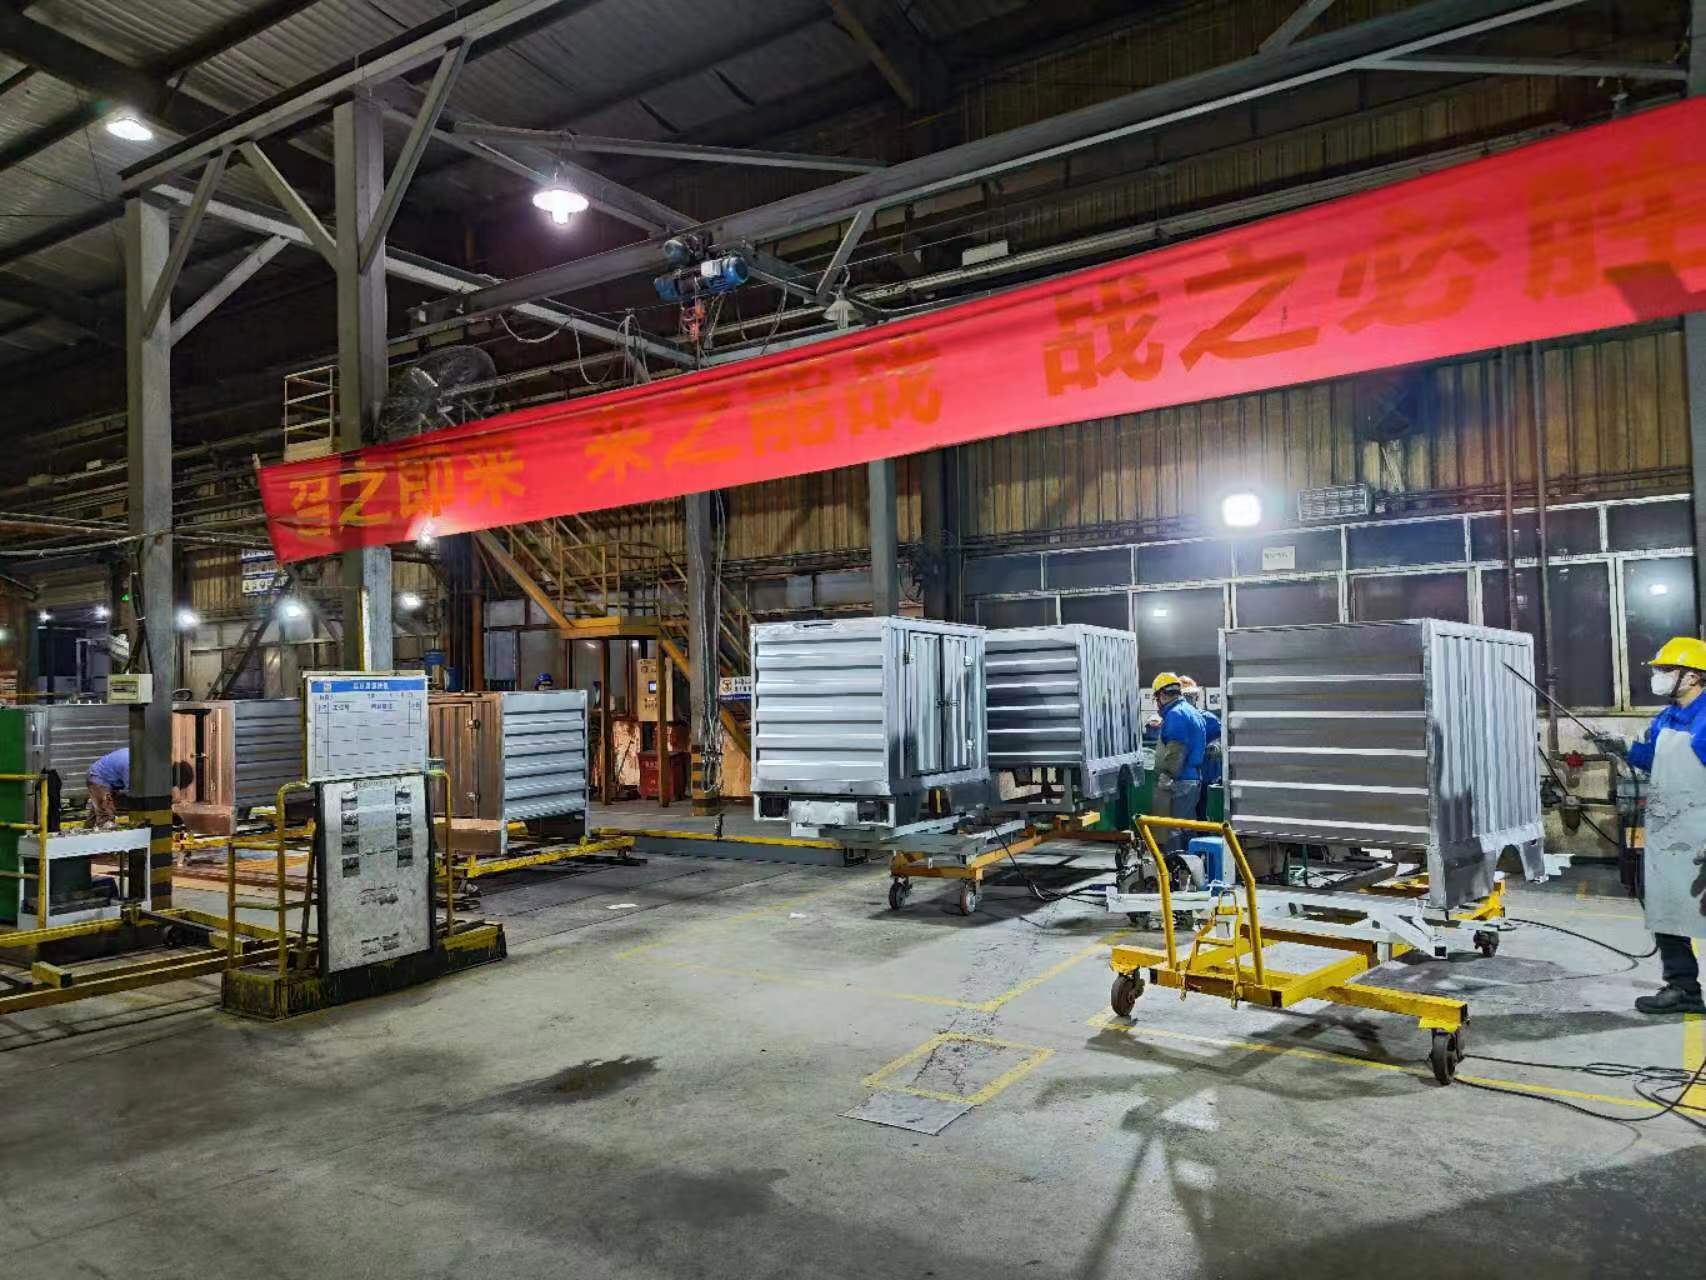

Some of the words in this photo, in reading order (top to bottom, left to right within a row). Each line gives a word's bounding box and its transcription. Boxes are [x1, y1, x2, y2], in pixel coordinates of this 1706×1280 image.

[289, 440, 525, 537] 召之即来
[1042, 137, 1706, 396] 战之必胜
